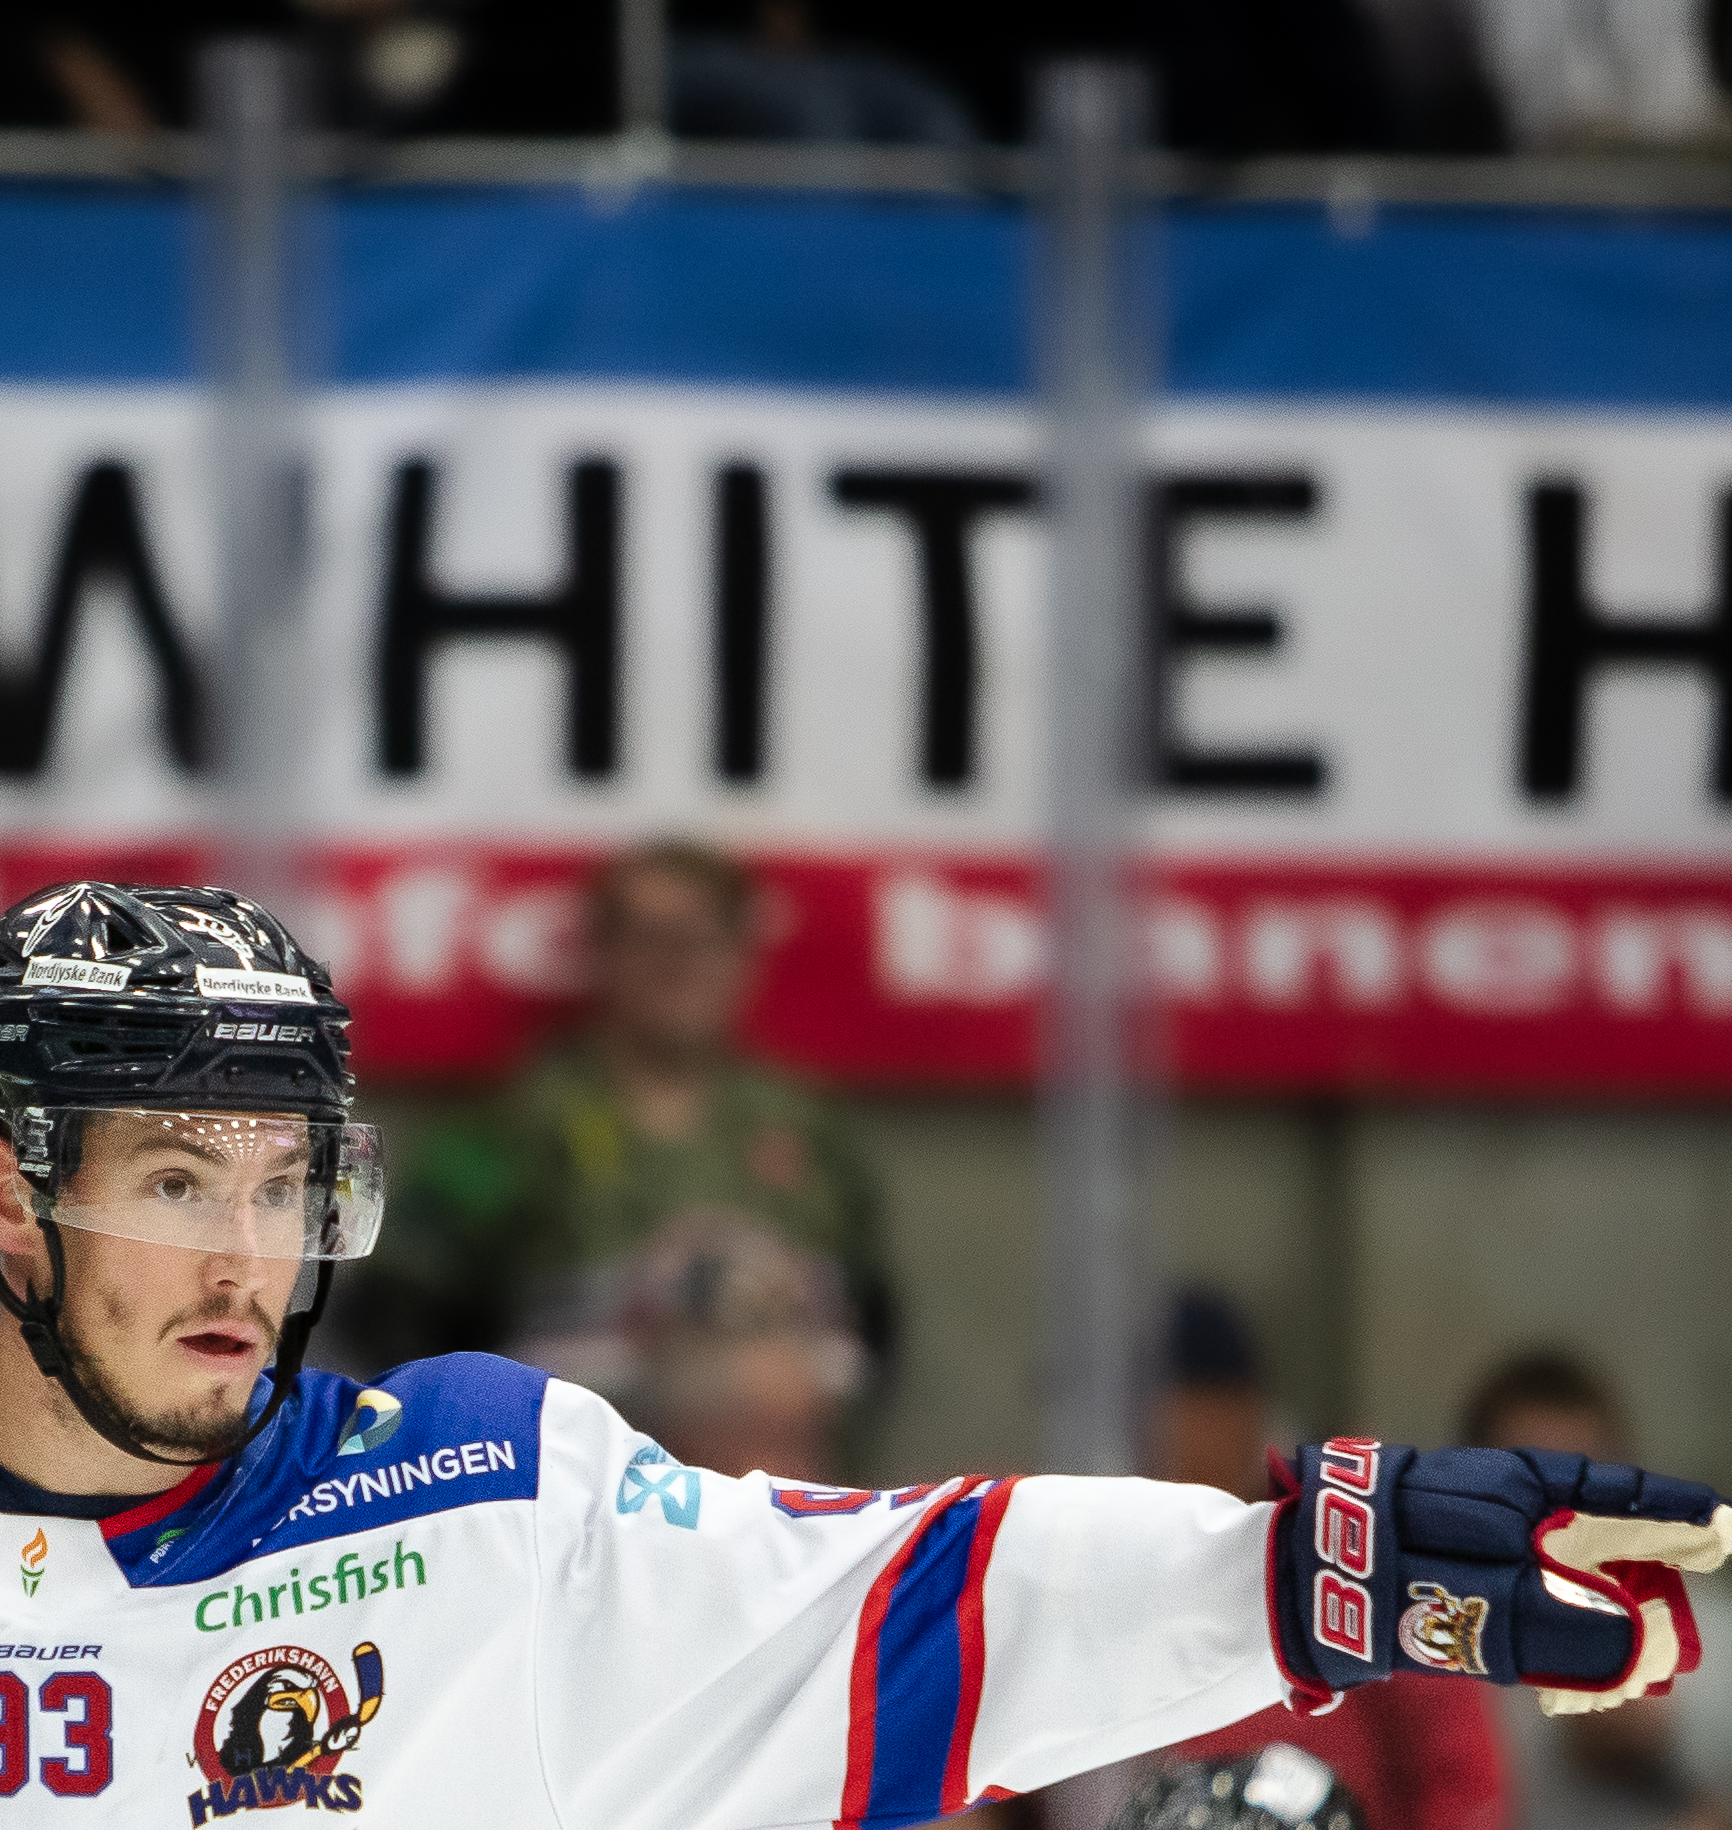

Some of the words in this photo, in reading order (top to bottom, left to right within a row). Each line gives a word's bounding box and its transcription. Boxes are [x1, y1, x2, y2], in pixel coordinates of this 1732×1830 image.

[28, 956, 87, 985] Nordjyske
[89, 961, 124, 987] Bank
[272, 982, 309, 999] Bank
[252, 1439, 517, 1547] RSYNINGEN
[194, 1541, 428, 1633] Chrisfish
[204, 1647, 340, 1714] FREDERIKSHAVN
[187, 1767, 363, 1830] HAWKS
